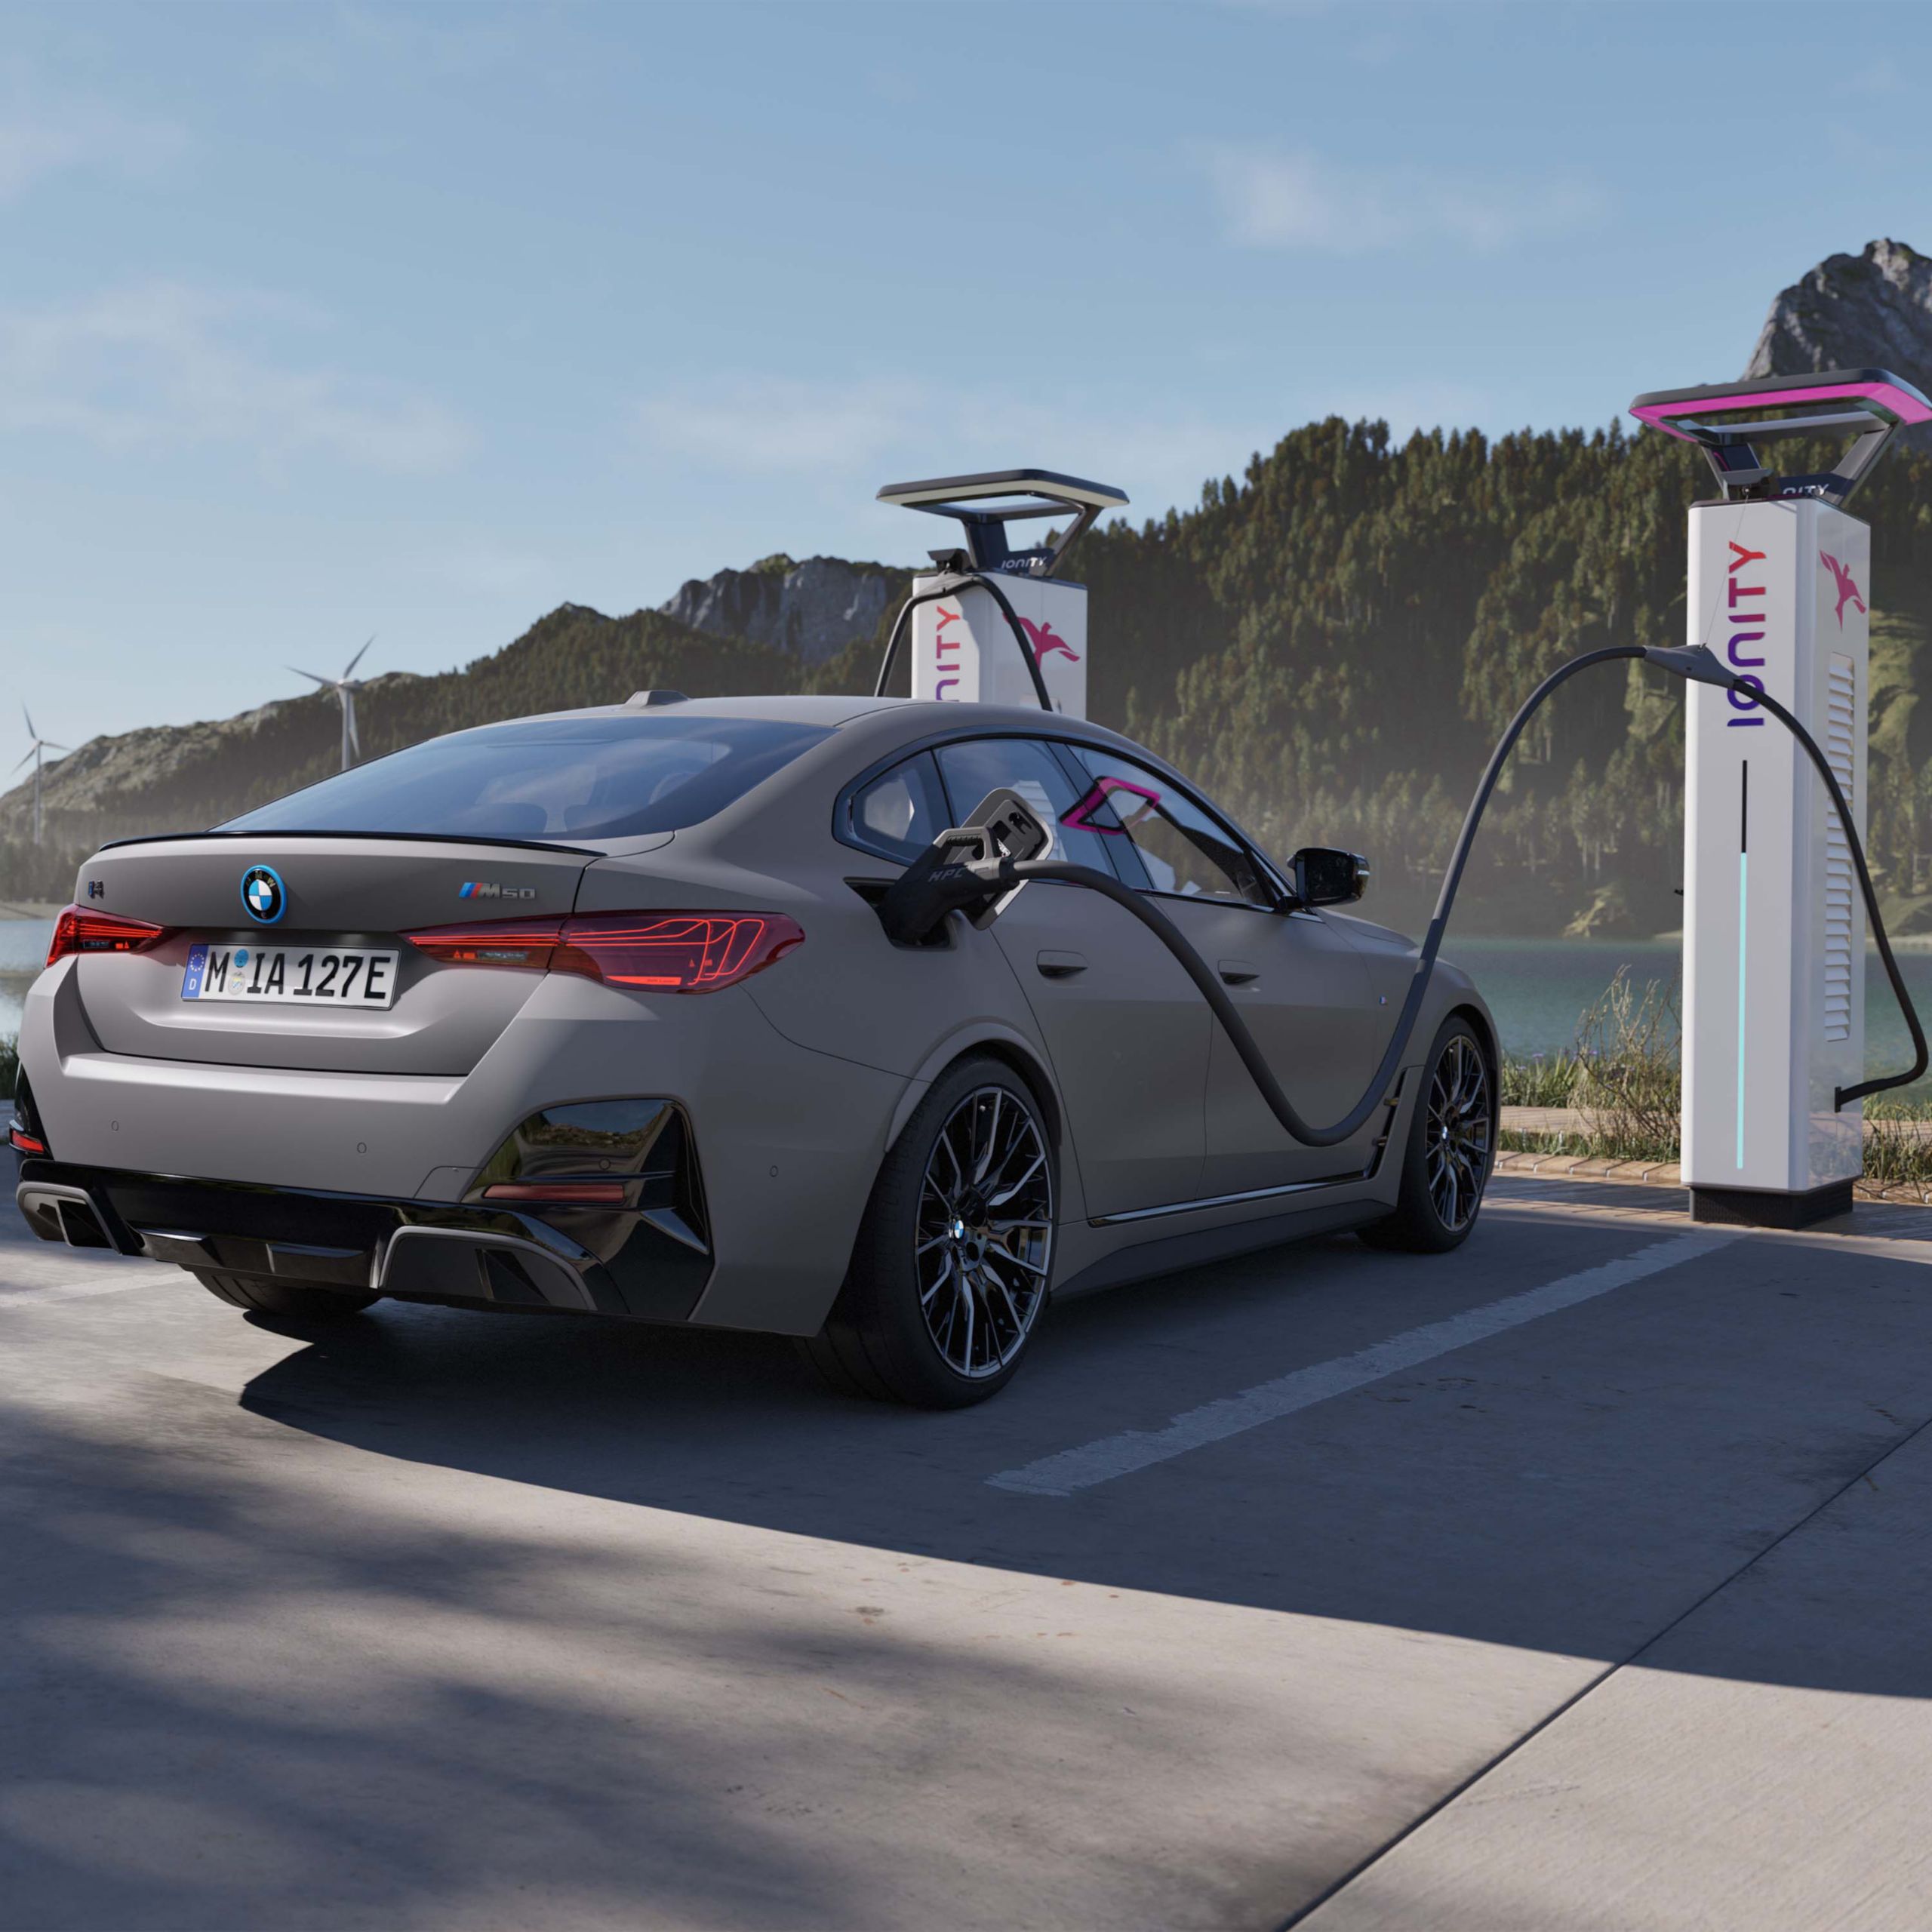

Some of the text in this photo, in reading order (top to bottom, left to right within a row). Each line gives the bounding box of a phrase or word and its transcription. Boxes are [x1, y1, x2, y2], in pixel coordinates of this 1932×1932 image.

[1001, 556, 1048, 568] IONITY
[1727, 540, 1767, 727] IONITY
[478, 883, 536, 900] M50
[189, 978, 196, 991] D
